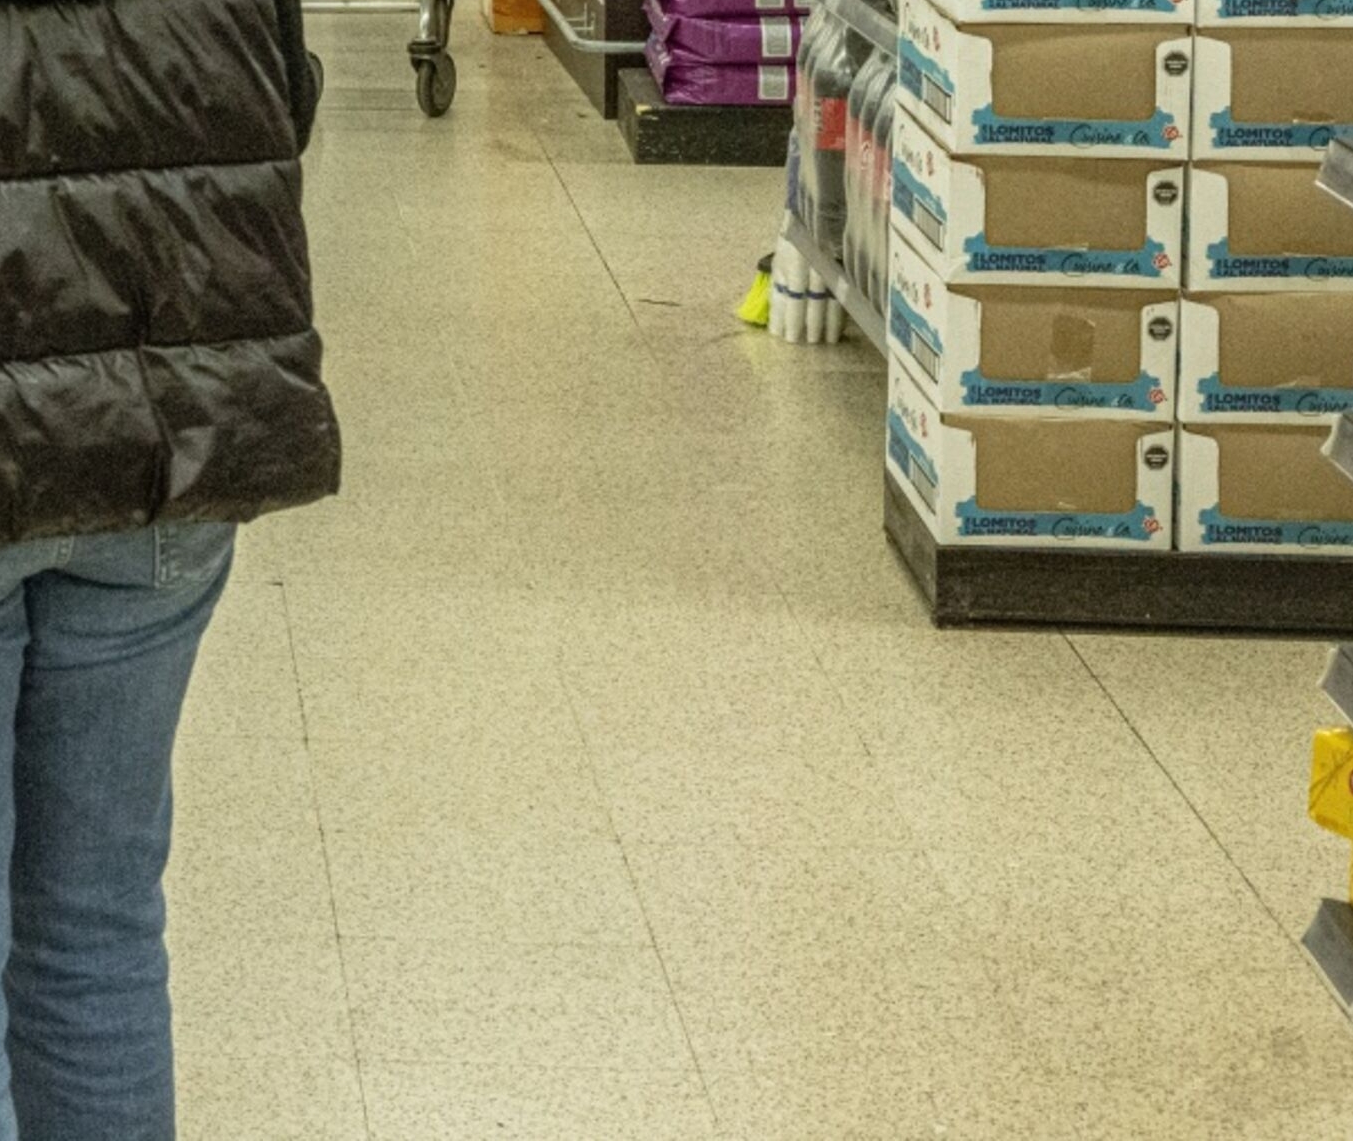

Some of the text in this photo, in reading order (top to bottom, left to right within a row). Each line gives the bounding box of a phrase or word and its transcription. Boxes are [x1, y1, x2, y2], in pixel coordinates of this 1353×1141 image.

[988, 124, 1055, 136] LOMITOS
[1227, 126, 1293, 138] LOMITOS
[980, 253, 1046, 266] LOMITOS
[1226, 258, 1290, 270] LOMITOS
[977, 385, 1042, 399] LOMITOS
[1217, 393, 1282, 406] LOMITOS
[972, 515, 1037, 528] LOMITOS
[1219, 525, 1284, 537] LOMITOS
